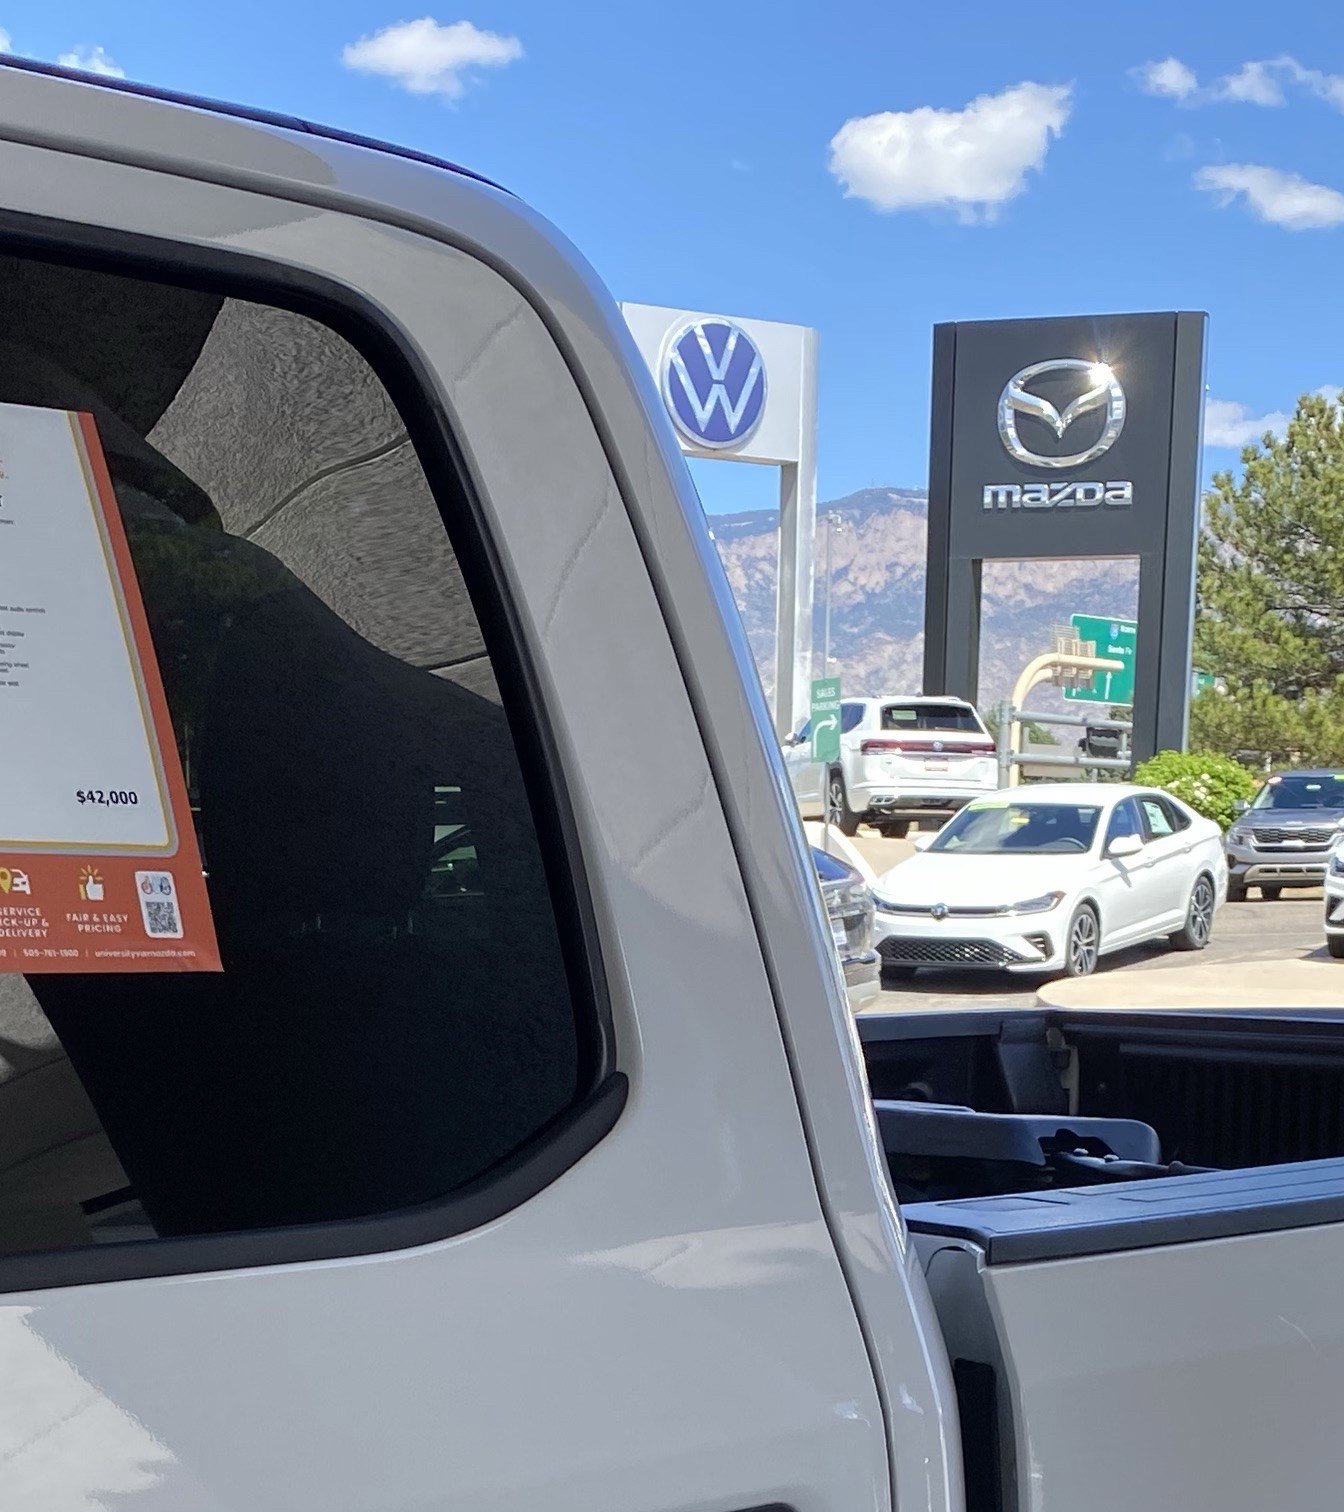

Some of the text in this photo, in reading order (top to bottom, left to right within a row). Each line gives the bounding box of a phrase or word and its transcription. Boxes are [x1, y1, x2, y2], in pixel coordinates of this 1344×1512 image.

[669, 322, 763, 436] VW
[816, 687, 836, 699] SALES
[76, 790, 138, 806] $42,000
[42, 918, 49, 927] &
[66, 913, 129, 923] FAIR & EASY
[77, 924, 122, 933] PRICING
